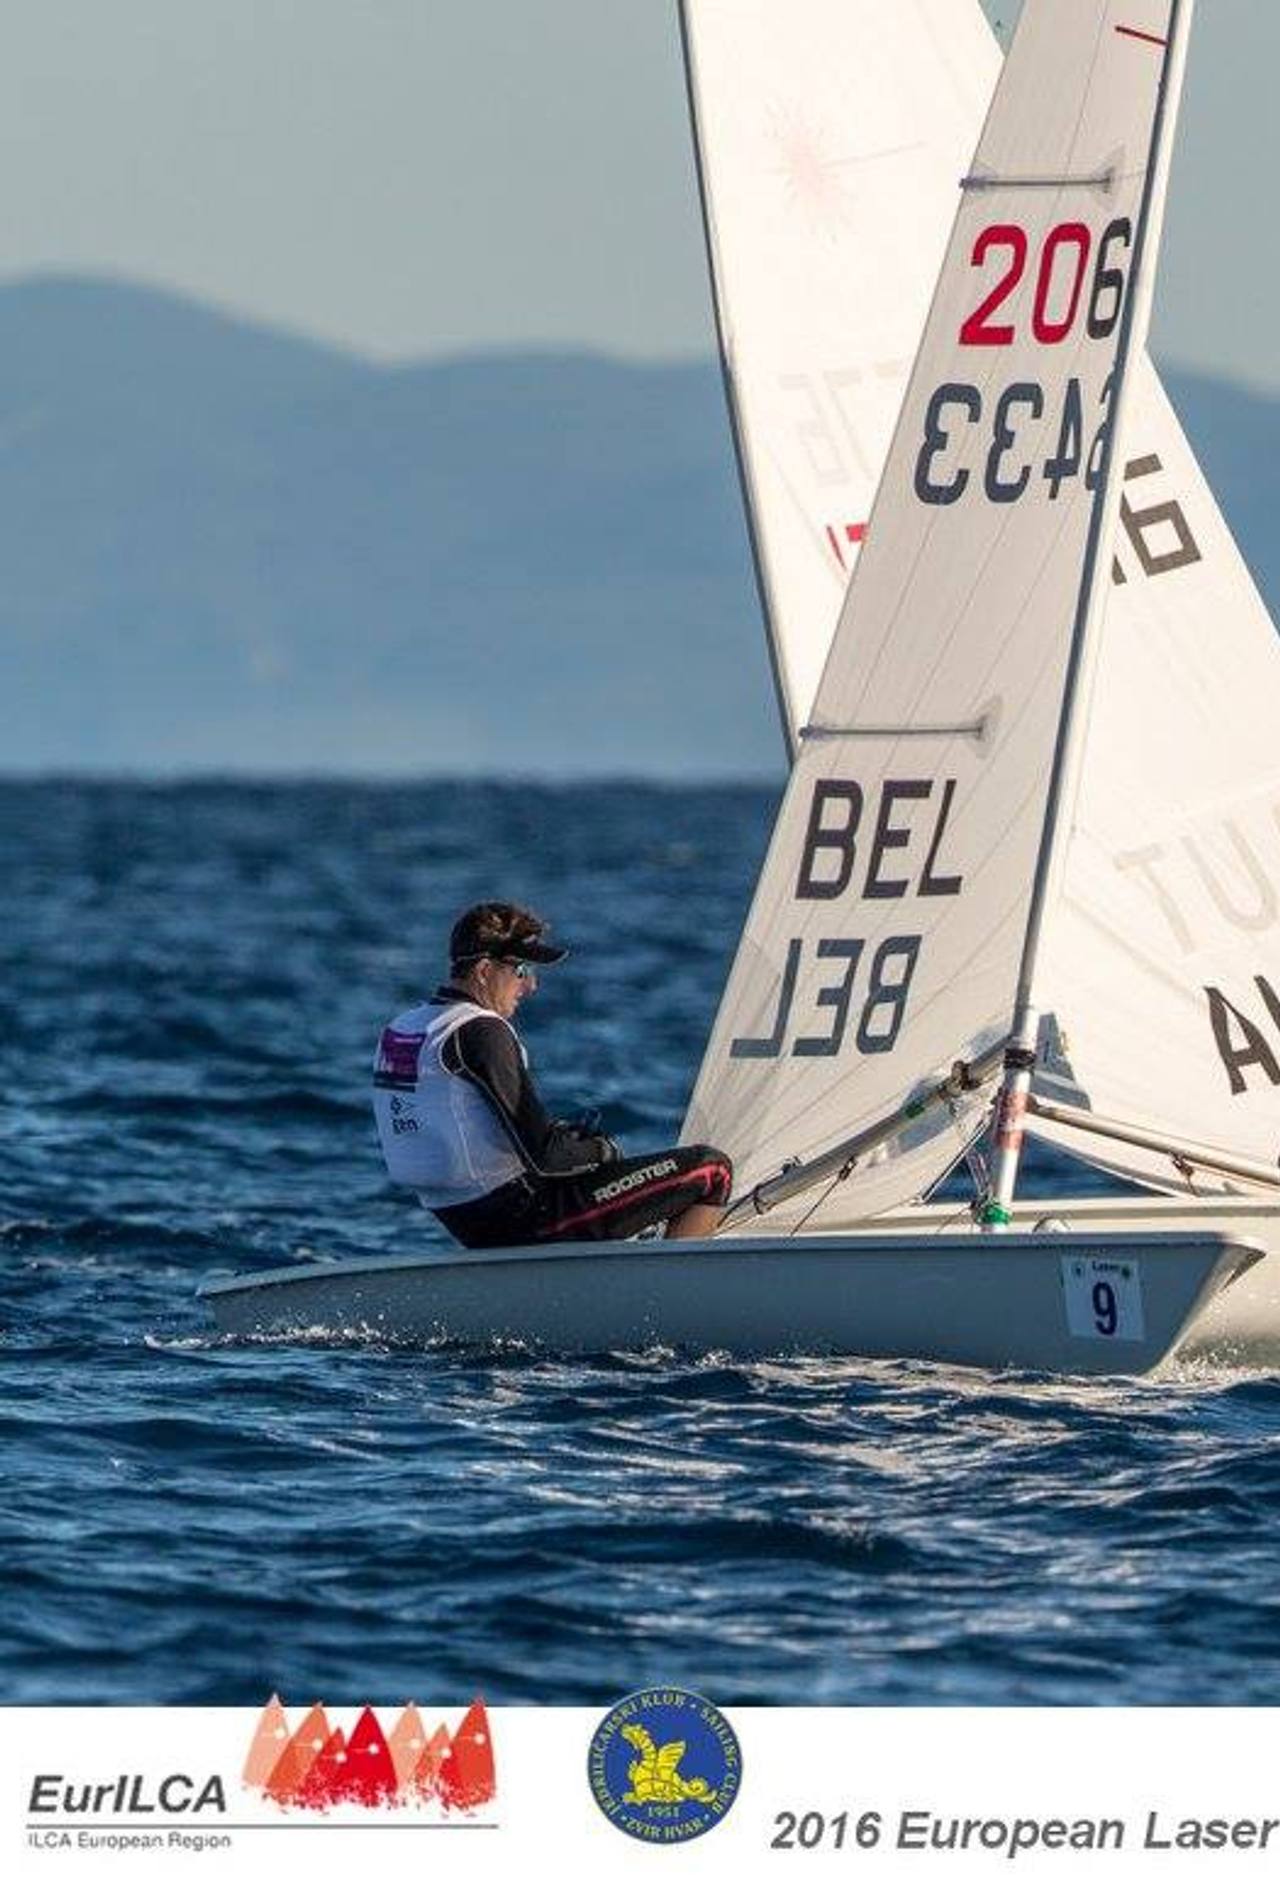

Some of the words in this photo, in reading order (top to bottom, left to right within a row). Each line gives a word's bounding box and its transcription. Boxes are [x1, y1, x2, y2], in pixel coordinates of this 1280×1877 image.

[958, 216, 1132, 347] 206
[794, 778, 964, 901] BEL
[592, 1158, 679, 1203] ROOSTER
[1091, 1281, 1118, 1336] 9
